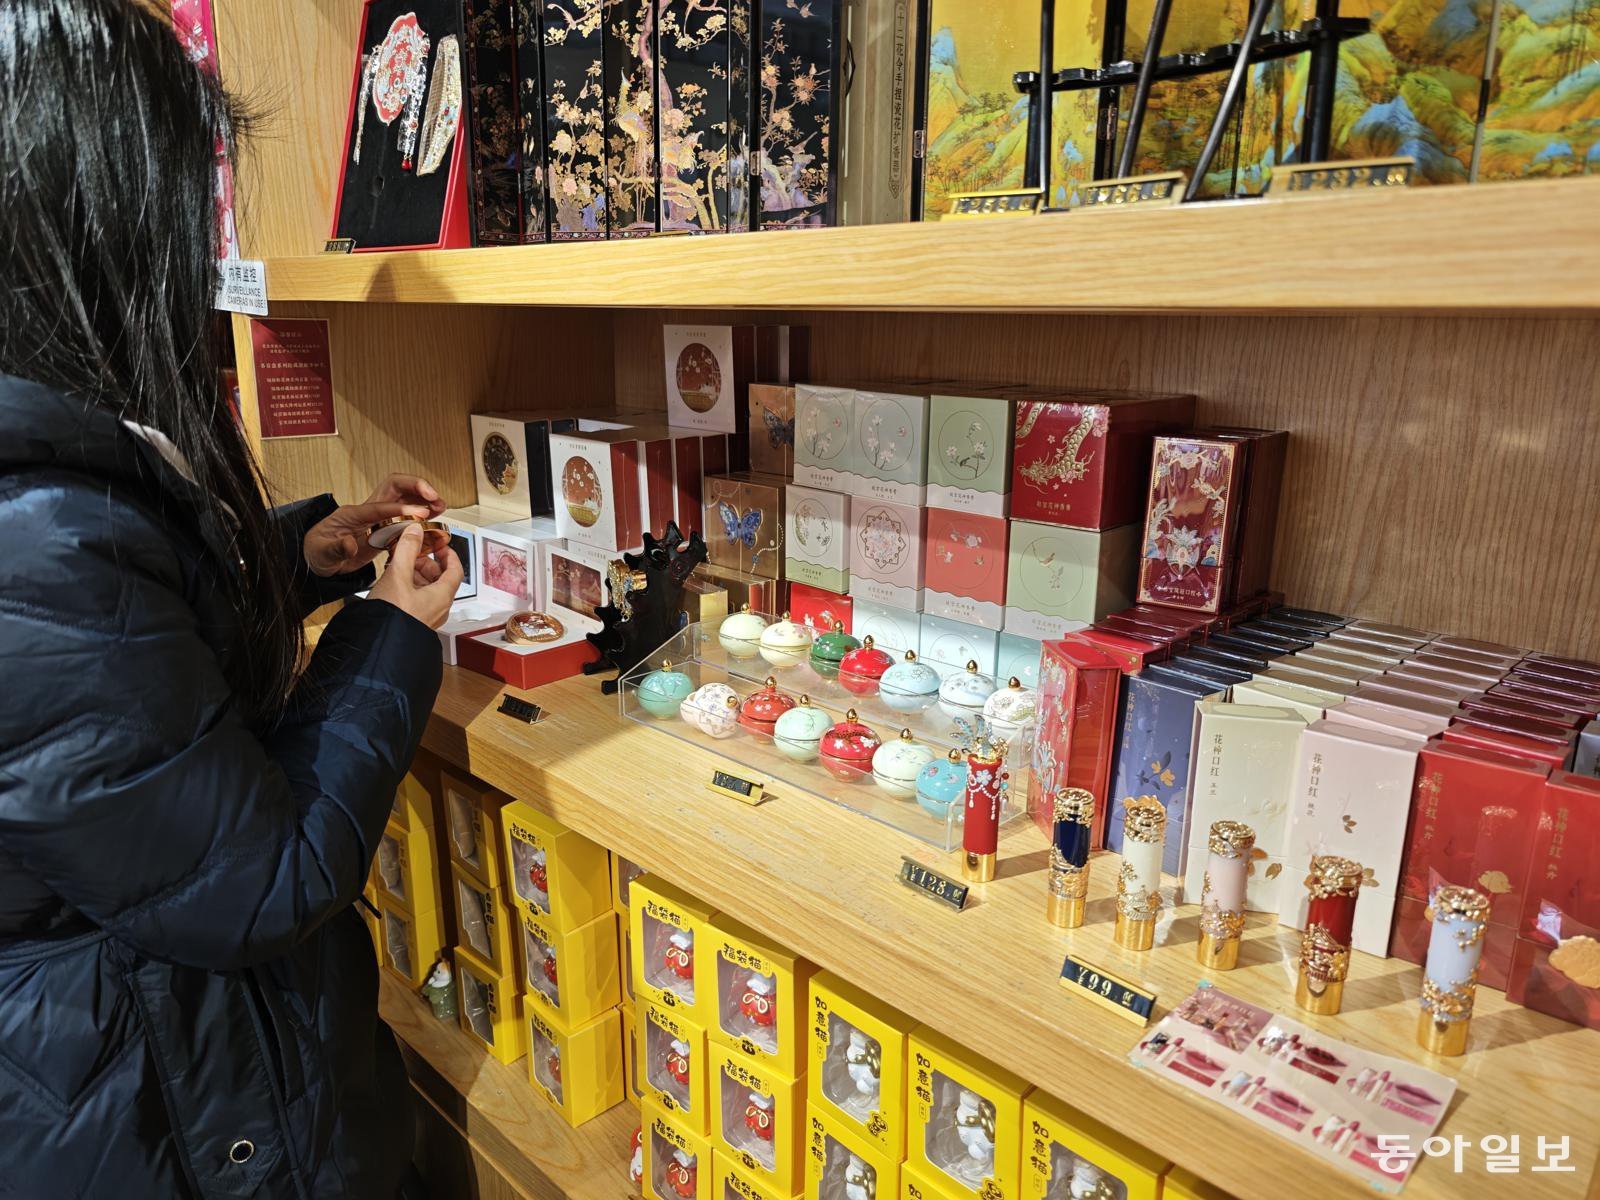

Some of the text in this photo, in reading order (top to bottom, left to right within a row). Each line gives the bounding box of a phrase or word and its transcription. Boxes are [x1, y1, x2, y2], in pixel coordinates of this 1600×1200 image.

[227, 286, 262, 297] SURVEILLANCE
[227, 295, 249, 306] CAMERAS
[255, 299, 264, 308] USE
[1210, 734, 1223, 776] 花神口红
[1307, 752, 1322, 797] 花神口红
[1425, 772, 1442, 819] 花神口红
[512, 822, 537, 843] 福袋猫
[1549, 808, 1569, 857] 花神口红
[526, 916, 548, 941] 福袋猫
[647, 900, 681, 925] 福袋猫
[723, 943, 762, 970] 福袋猫
[650, 1006, 680, 1036] 福袋猫
[815, 996, 828, 1043] 如意猫
[726, 1058, 762, 1090] 福袋猫
[915, 1052, 931, 1103] 如意猫
[656, 1118, 687, 1149] 福袋猫
[811, 1117, 824, 1162] 如意猫
[1030, 1120, 1049, 1175] 如意猫
